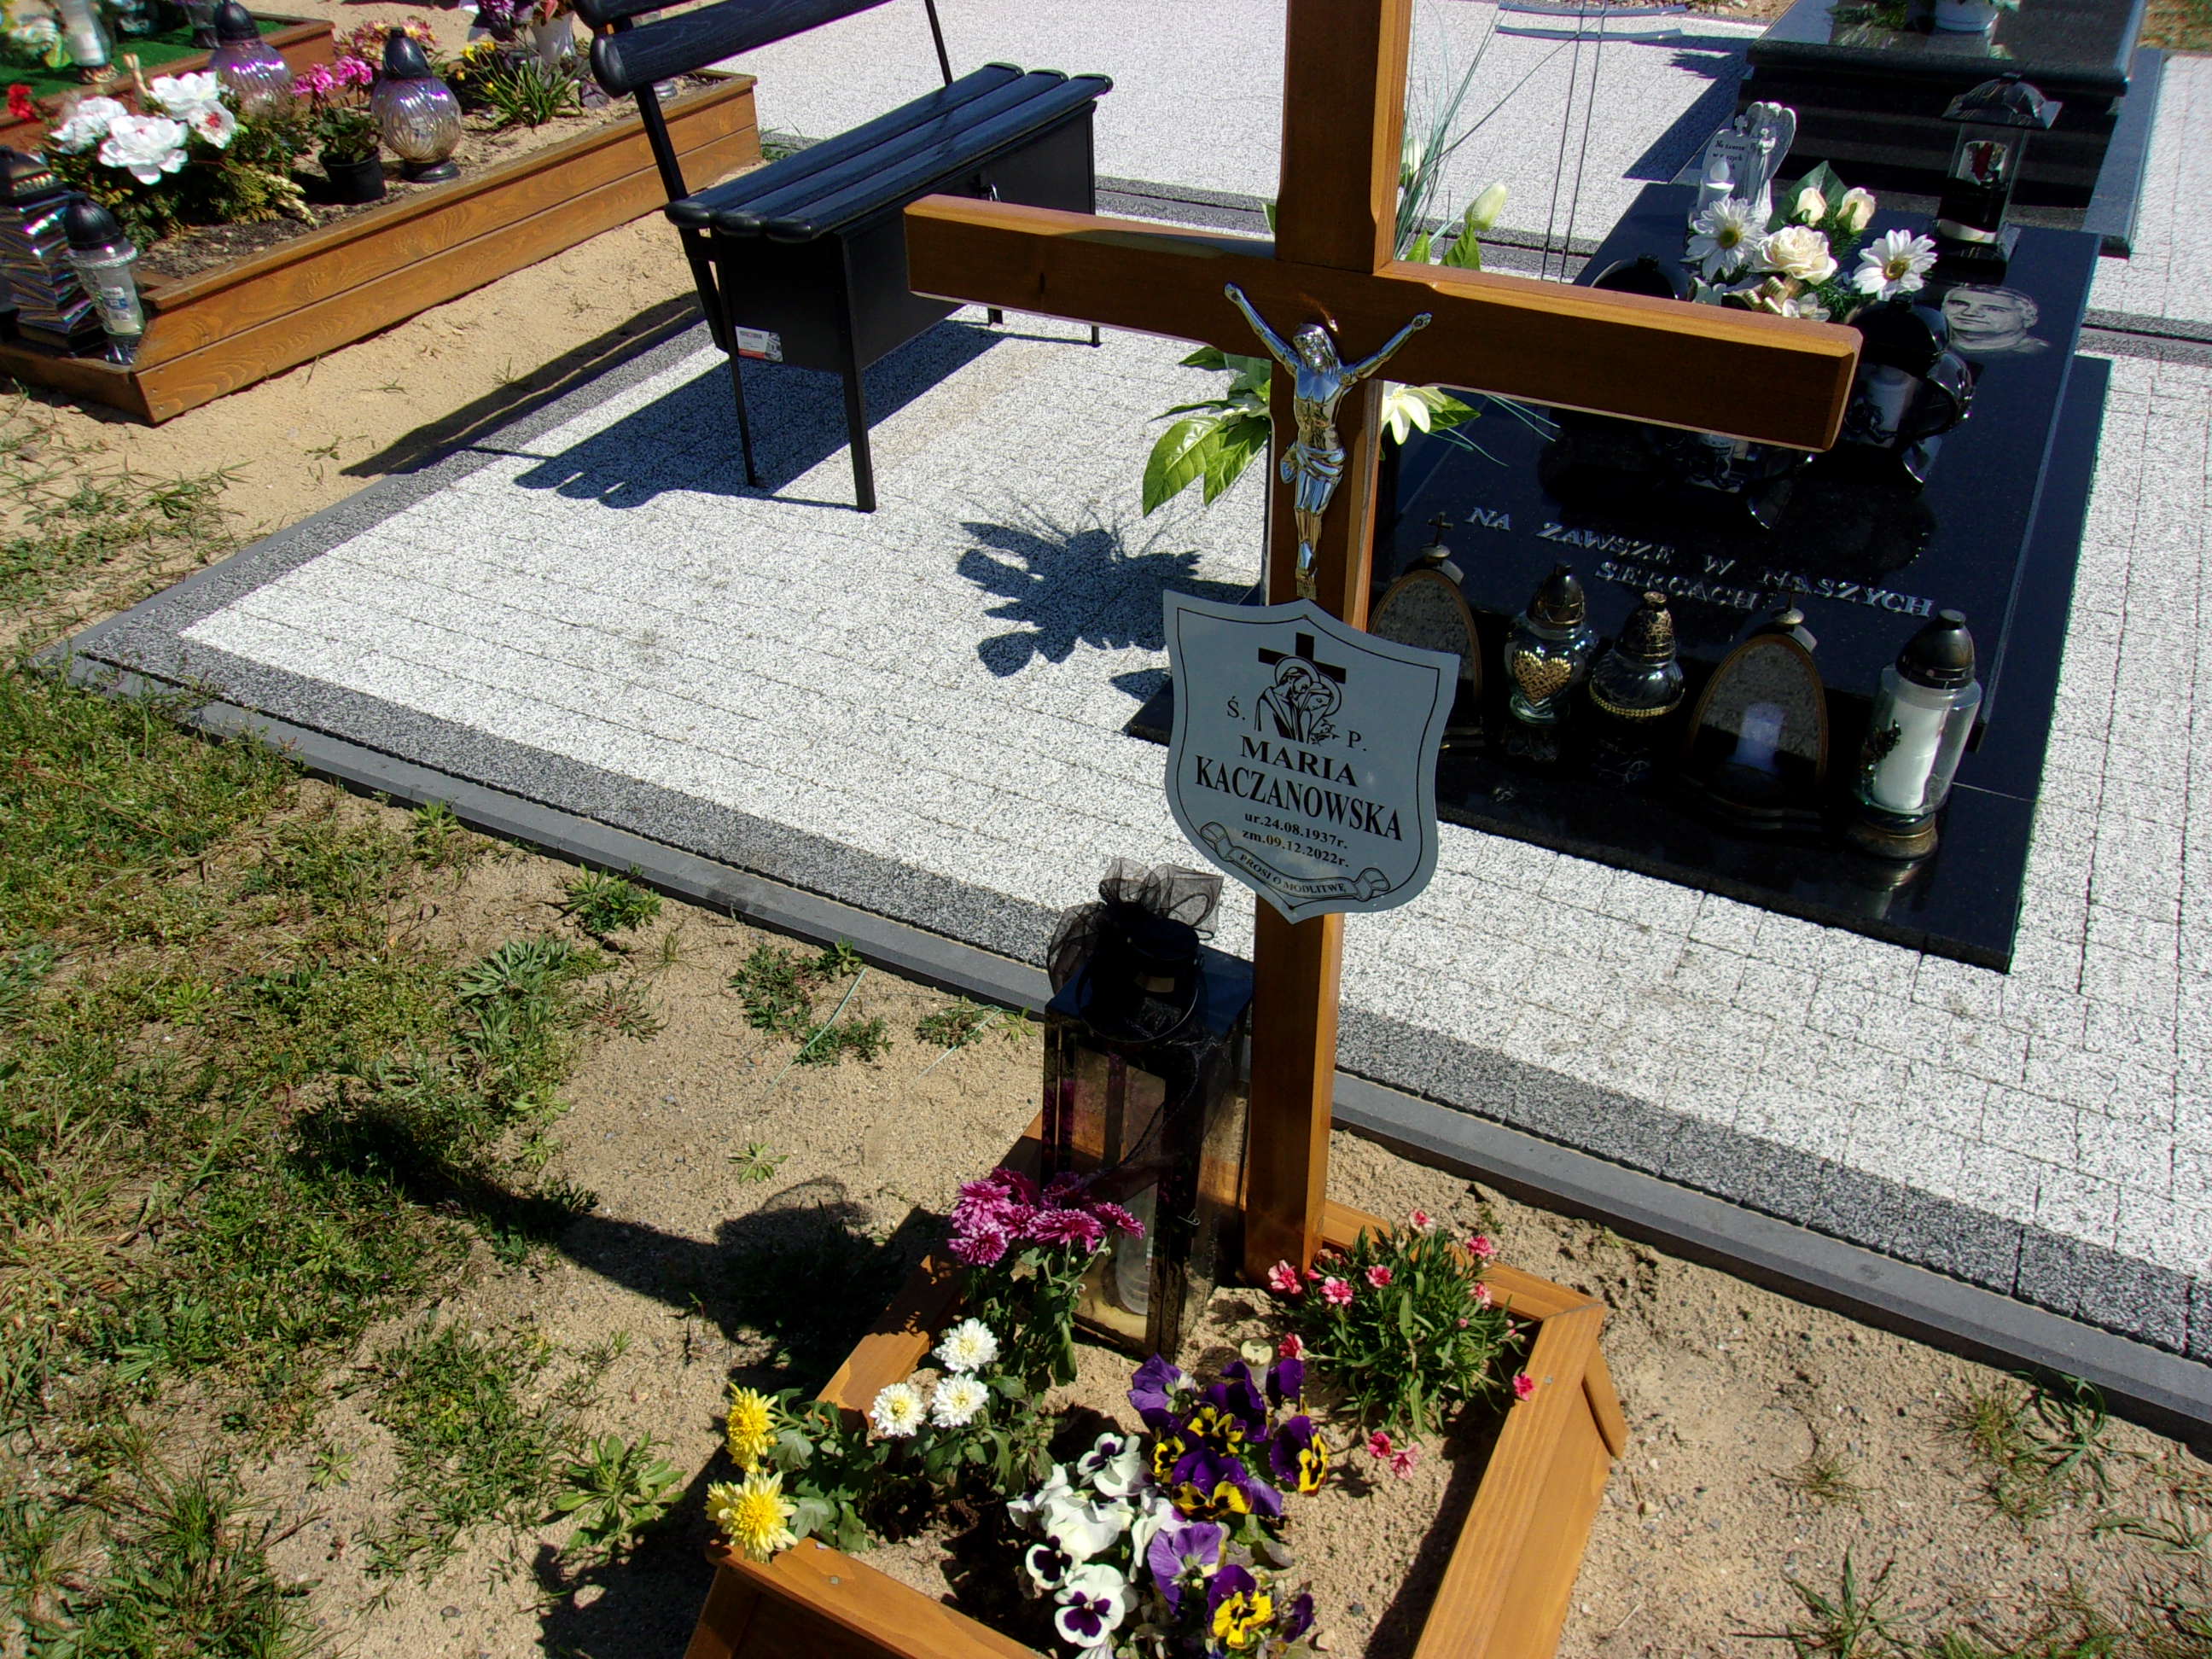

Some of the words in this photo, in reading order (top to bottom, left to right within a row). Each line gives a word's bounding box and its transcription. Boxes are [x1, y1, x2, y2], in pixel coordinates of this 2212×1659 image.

[1464, 506, 1511, 532] NA
[1535, 521, 1675, 565] ZAWSZE
[1702, 554, 1737, 576] W
[1760, 570, 1935, 618] NASZYCH
[1594, 561, 1760, 610] SERCACH
[1226, 696, 1246, 721] Ś.
[1347, 730, 1367, 752] P.
[1239, 734, 1359, 788] MARIA
[1195, 754, 1403, 841] KACZANOWSKA
[1242, 830, 1350, 868] zm.09.12.2022r.
[1243, 812, 1348, 849] ur.24.08.1937r.
[1239, 853, 1272, 880] PROSI
[1272, 876, 1282, 885] O
[1283, 881, 1348, 894] MODLITWĘ
